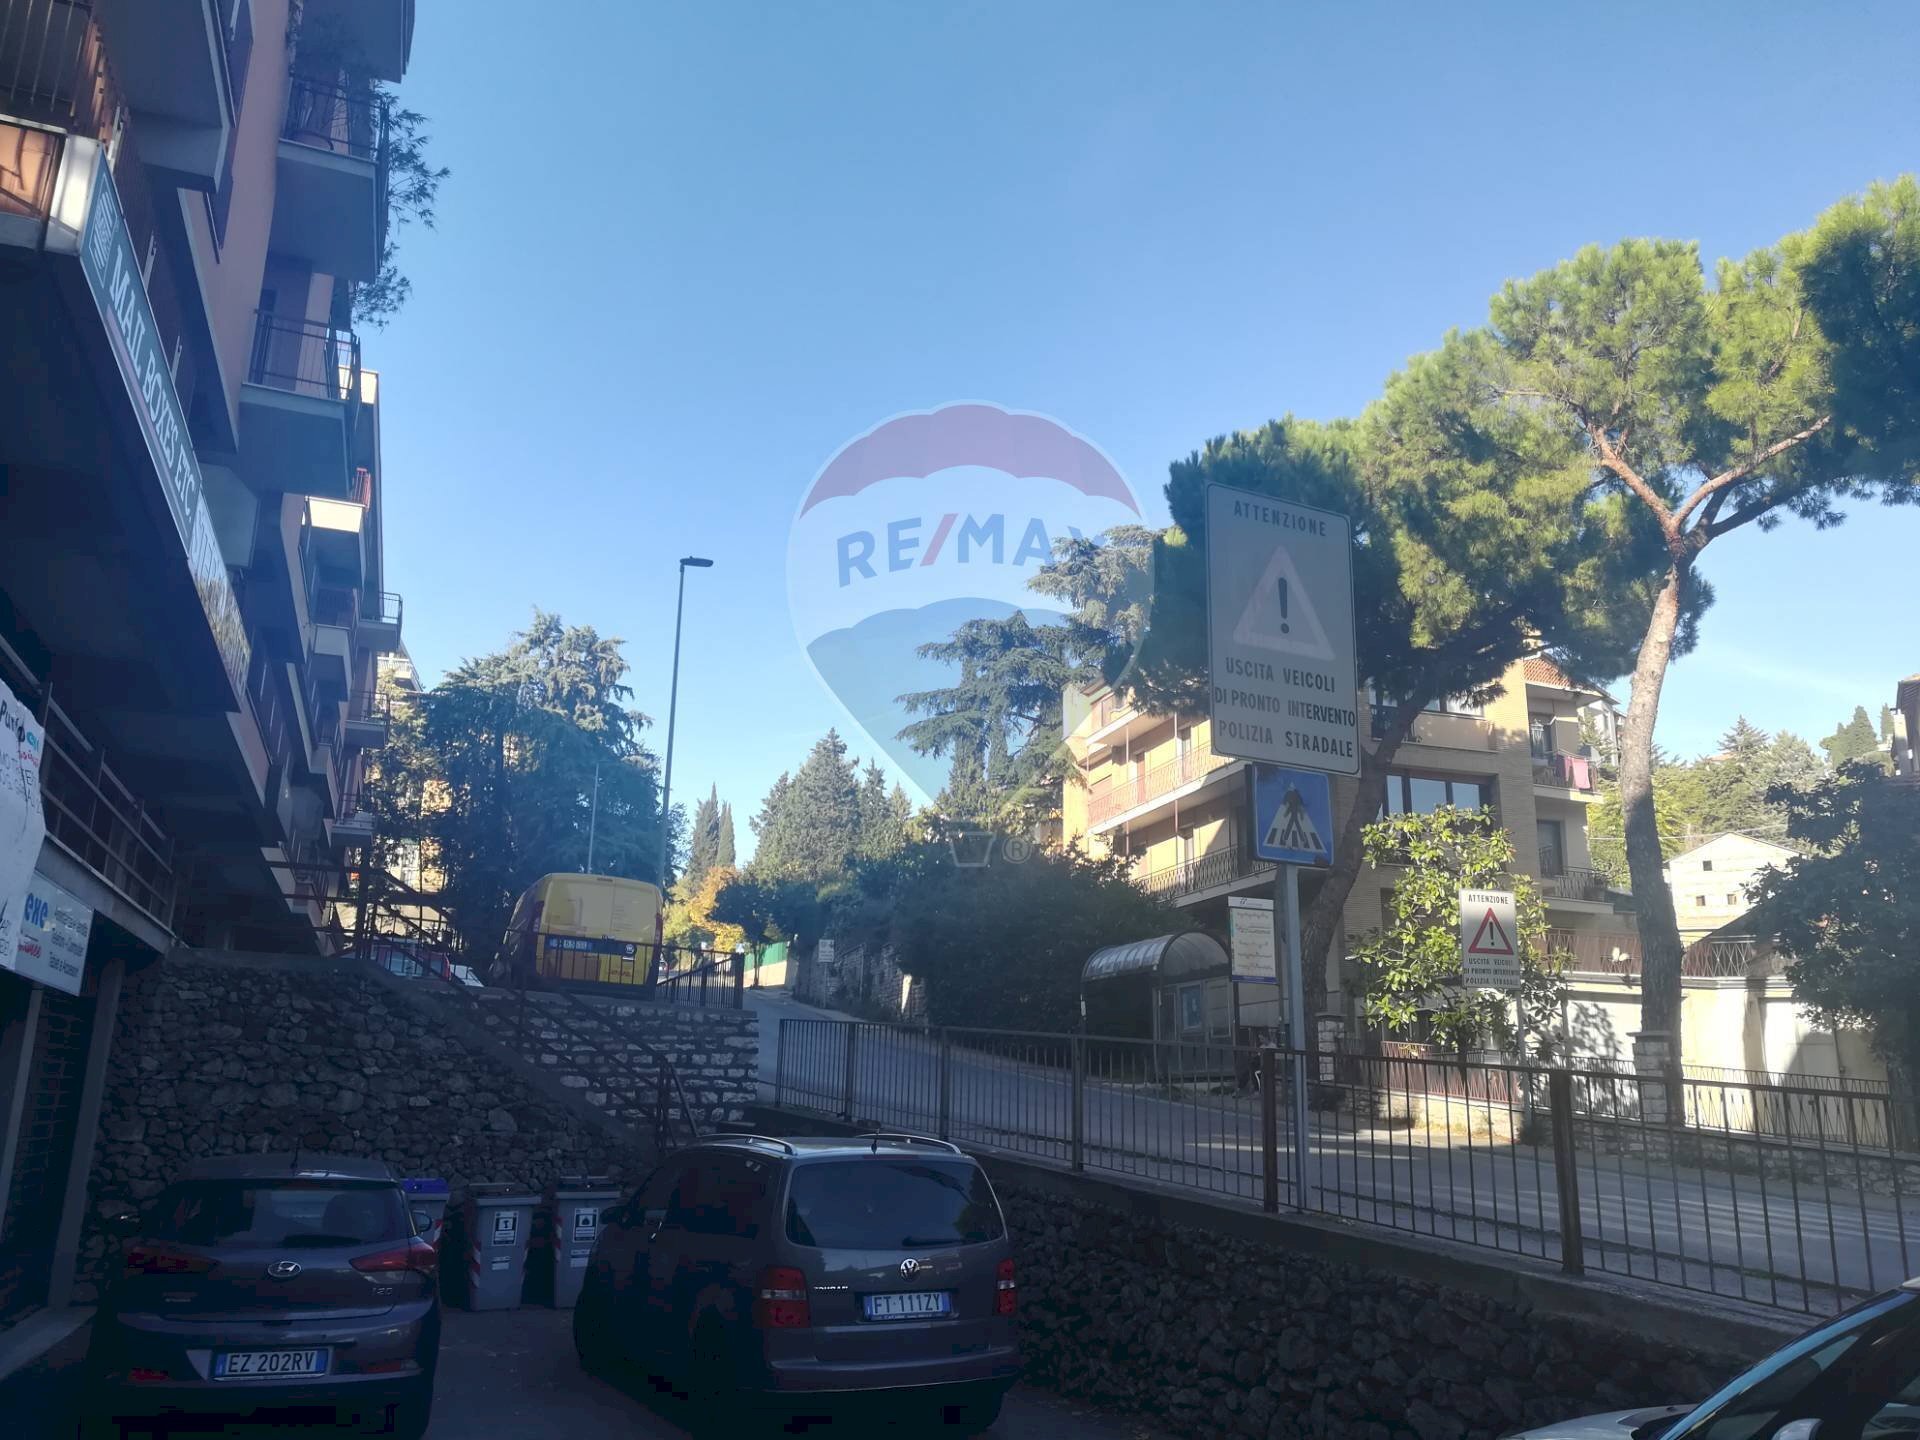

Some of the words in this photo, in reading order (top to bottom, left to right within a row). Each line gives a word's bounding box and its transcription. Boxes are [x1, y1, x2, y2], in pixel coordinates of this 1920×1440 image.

[109, 244, 147, 377] MAIL
[141, 348, 180, 470] BOXES
[174, 442, 197, 522] ETC.
[1233, 500, 1327, 537] ATTENZIONE
[1225, 656, 1275, 682] USCITA
[1282, 667, 1336, 693] VEICOLI
[1214, 686, 1228, 705] DI
[1231, 689, 1281, 714] PRONTO
[1287, 699, 1356, 728] INTERVENTO
[1218, 719, 1274, 745] POLIZIA
[1284, 730, 1354, 758] STRADALE
[24, 891, 49, 929] exe
[1468, 894, 1509, 905] ATTENZIONE
[1468, 957, 1490, 966] USCITA
[873, 1296, 892, 1315] FT
[898, 1293, 941, 1313] 111ZY
[227, 1354, 250, 1374] EZ
[257, 1351, 316, 1373] 202RV
